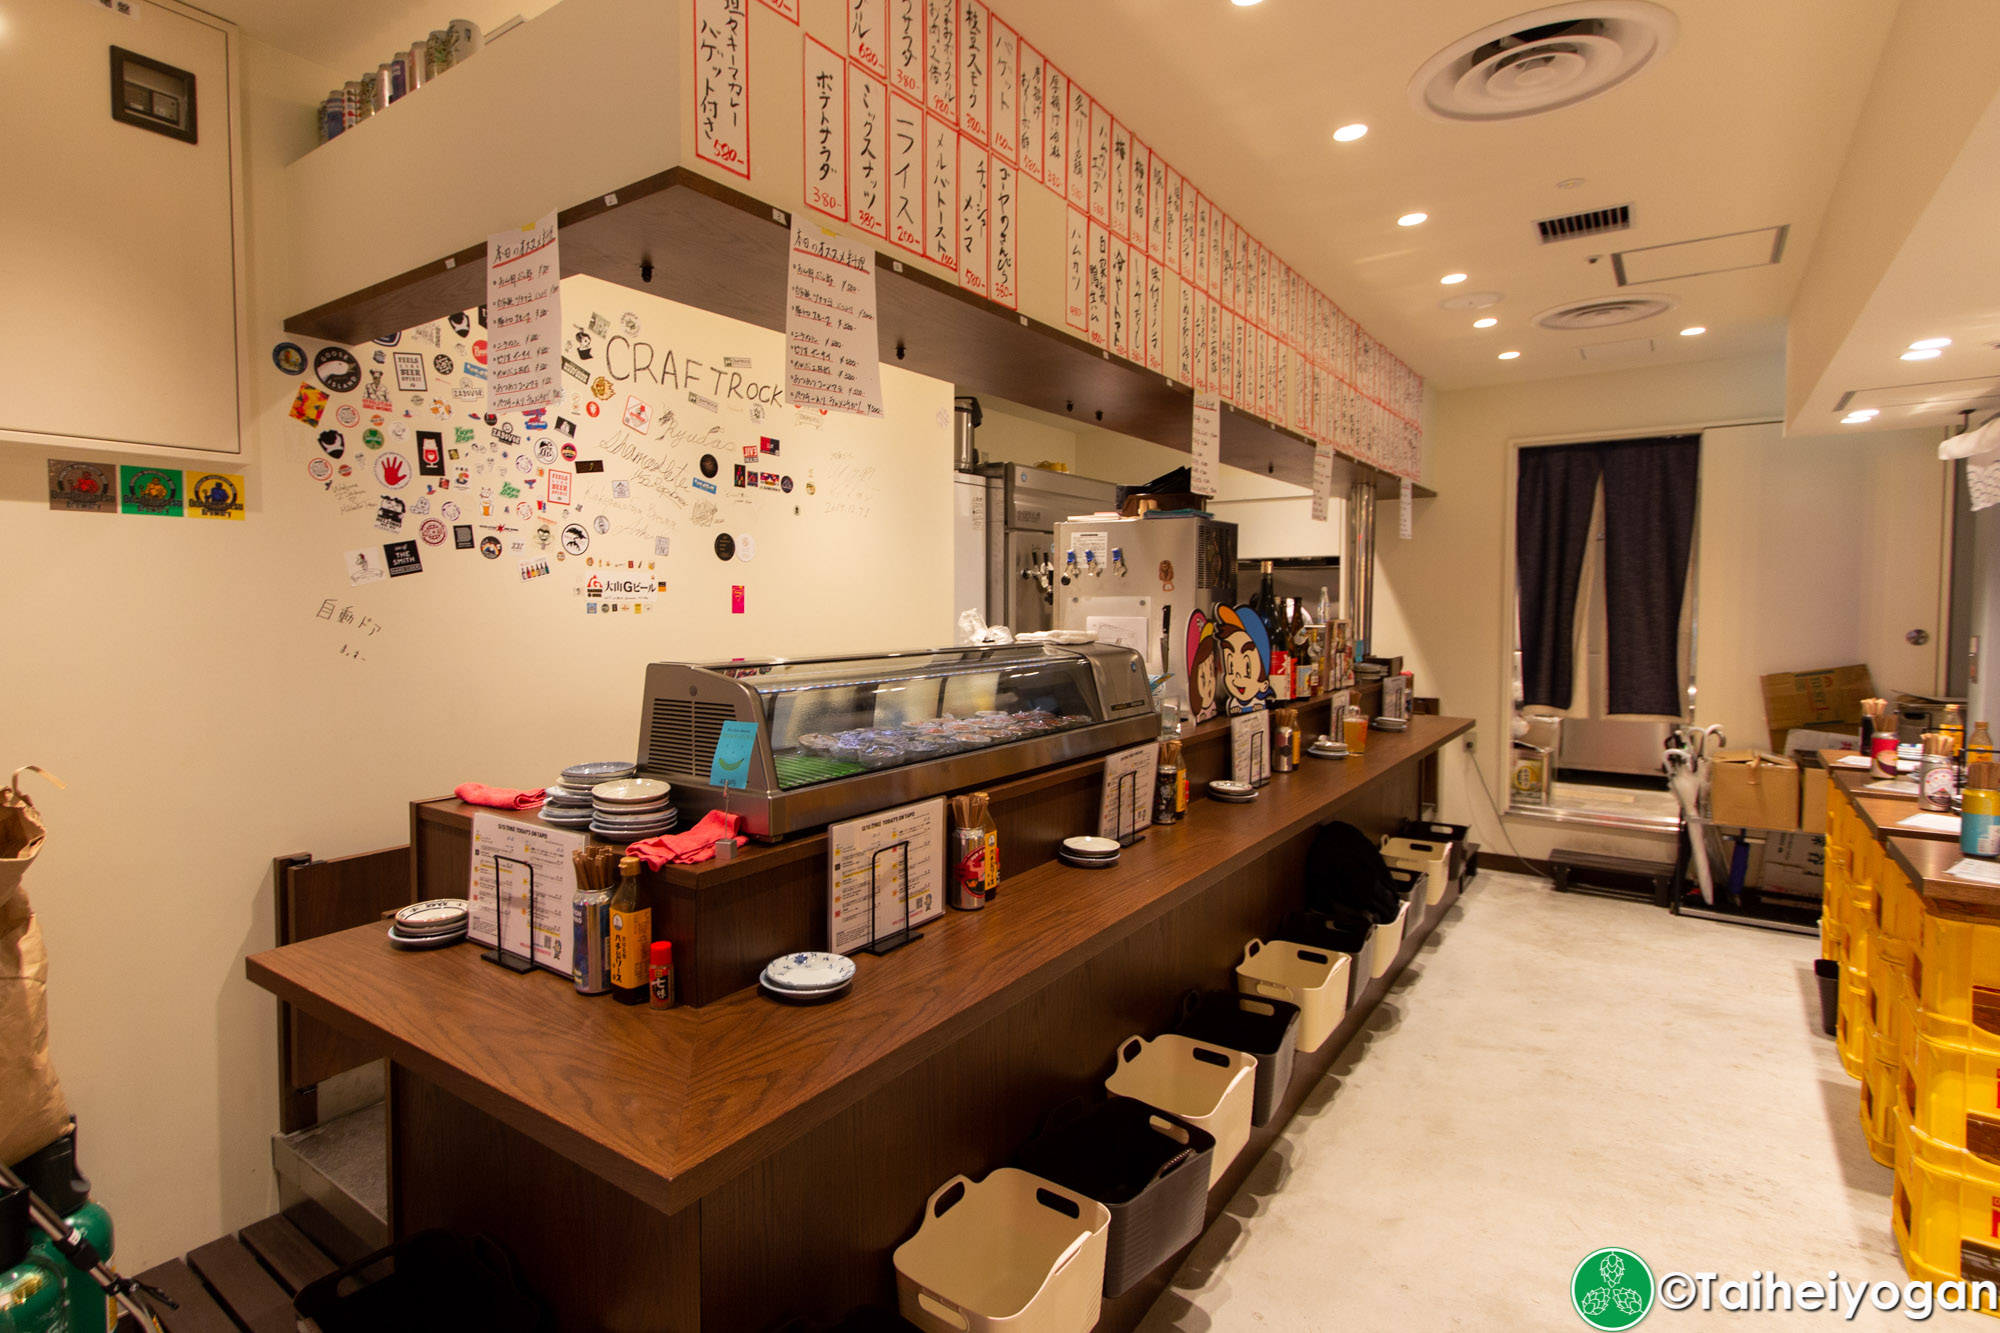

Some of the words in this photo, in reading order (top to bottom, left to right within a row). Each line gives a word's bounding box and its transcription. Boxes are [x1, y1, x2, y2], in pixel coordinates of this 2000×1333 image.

[896, 68, 921, 91] 380-
[816, 71, 838, 181] ポテトサラダ
[860, 83, 877, 210] ミックスナッツ
[894, 118, 915, 225] ライス
[812, 187, 842, 209] 380-
[933, 133, 949, 253] メルバトースト
[1071, 228, 1082, 292] ハムカツ
[319, 349, 350, 363] GOOSE
[397, 356, 419, 364] FEELS
[399, 368, 421, 376] BEER
[326, 375, 359, 390] ISLAND
[551, 484, 568, 492] BEER
[392, 556, 416, 566] SMITH
[395, 550, 411, 558] THE
[604, 580, 657, 593] 大山Gビール
[315, 598, 382, 636] 自動ドア
